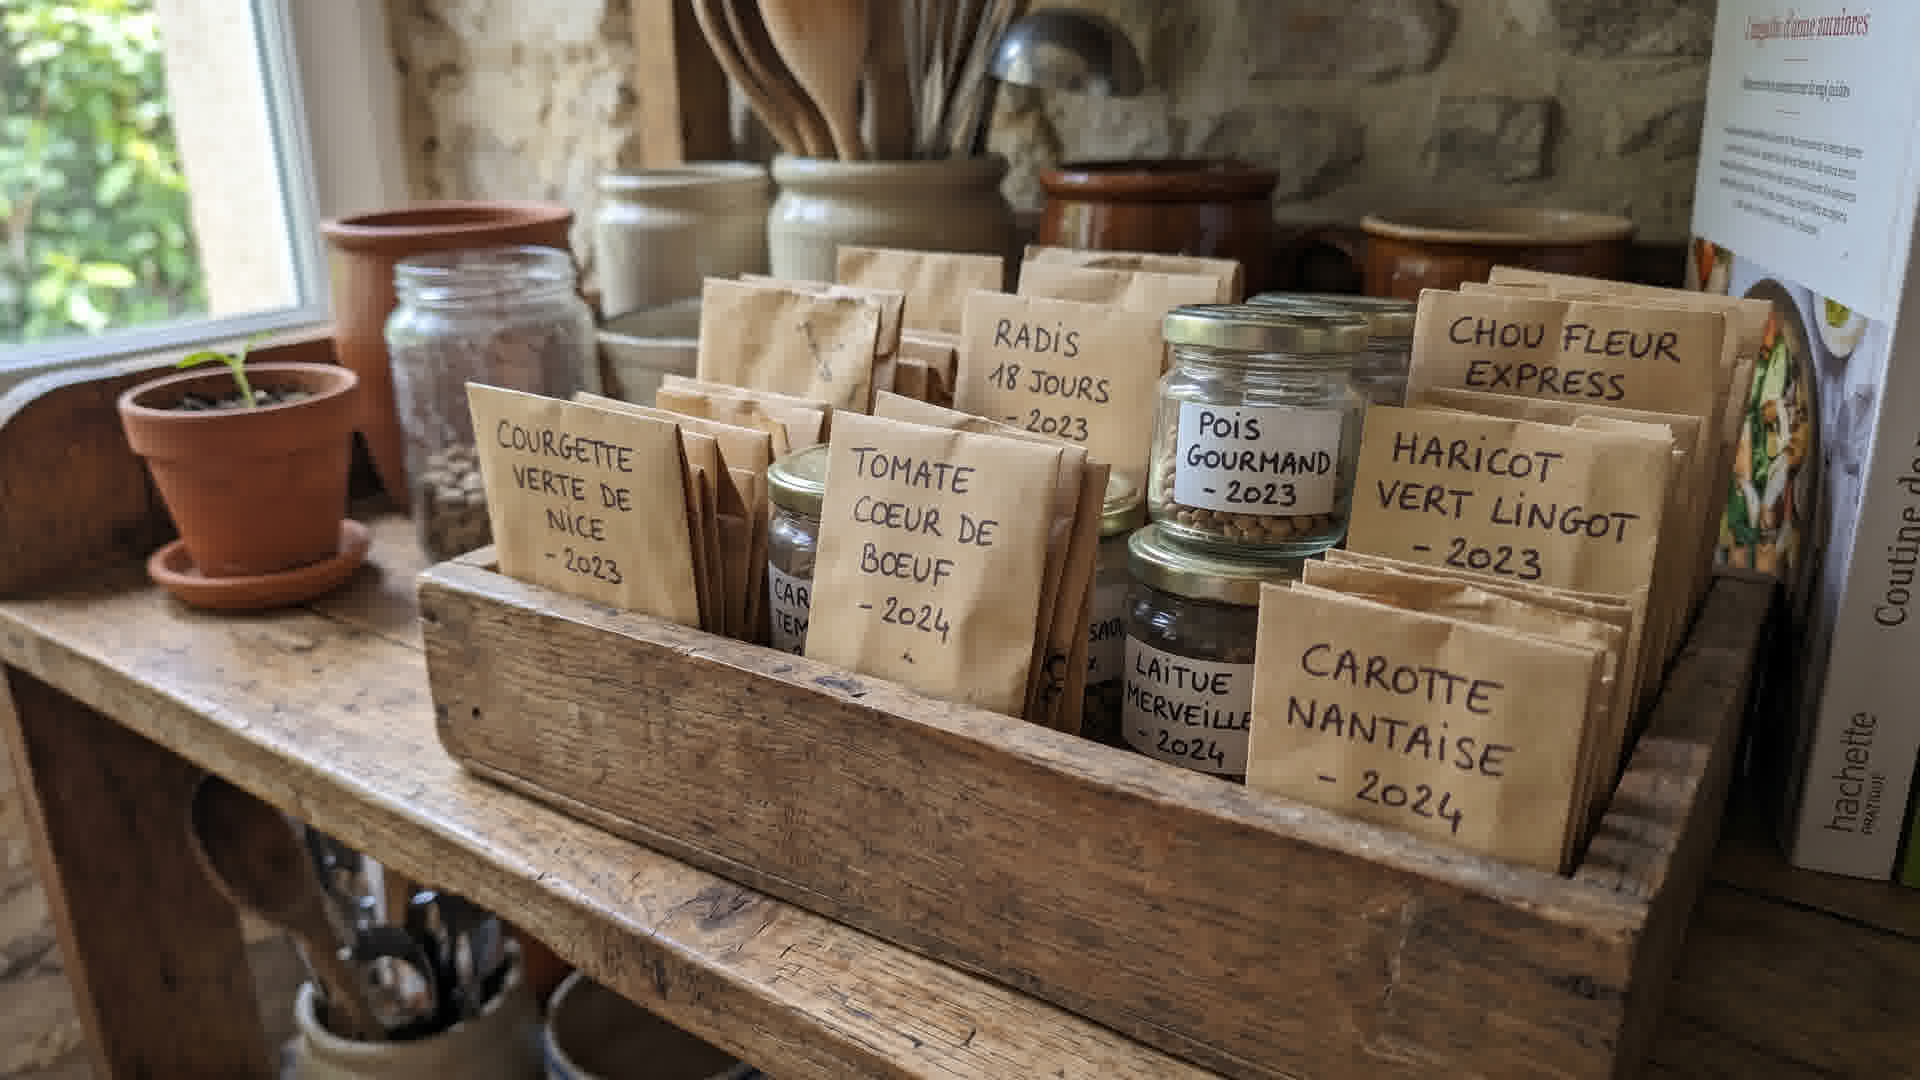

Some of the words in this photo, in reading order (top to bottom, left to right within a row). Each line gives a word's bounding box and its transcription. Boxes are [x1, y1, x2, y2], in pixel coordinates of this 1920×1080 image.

[1449, 315, 1545, 349] CHOU
[1562, 323, 1681, 363] FLEUR
[988, 362, 1020, 392] 18
[1028, 369, 1111, 404] JOURS
[1465, 360, 1625, 401] EXPRESS
[1025, 407, 1089, 441] 2023
[496, 418, 634, 473] COURGETTE
[1187, 443, 1332, 475] GOURMAND
[512, 466, 586, 502] VERTE
[599, 482, 633, 513] DE
[851, 446, 976, 494] TOMATE
[1225, 482, 1298, 507] 2023
[1376, 479, 1474, 520] VERT
[545, 507, 606, 542] NICE
[957, 513, 999, 547] DE
[563, 548, 623, 585] 2023
[1445, 536, 1542, 581] 2023
[881, 596, 950, 645] 2024
[1301, 643, 1505, 715] CAROTTE
[1157, 729, 1225, 769] 2024
[1824, 712, 1879, 832] hachette
[1355, 769, 1464, 834] 2024
